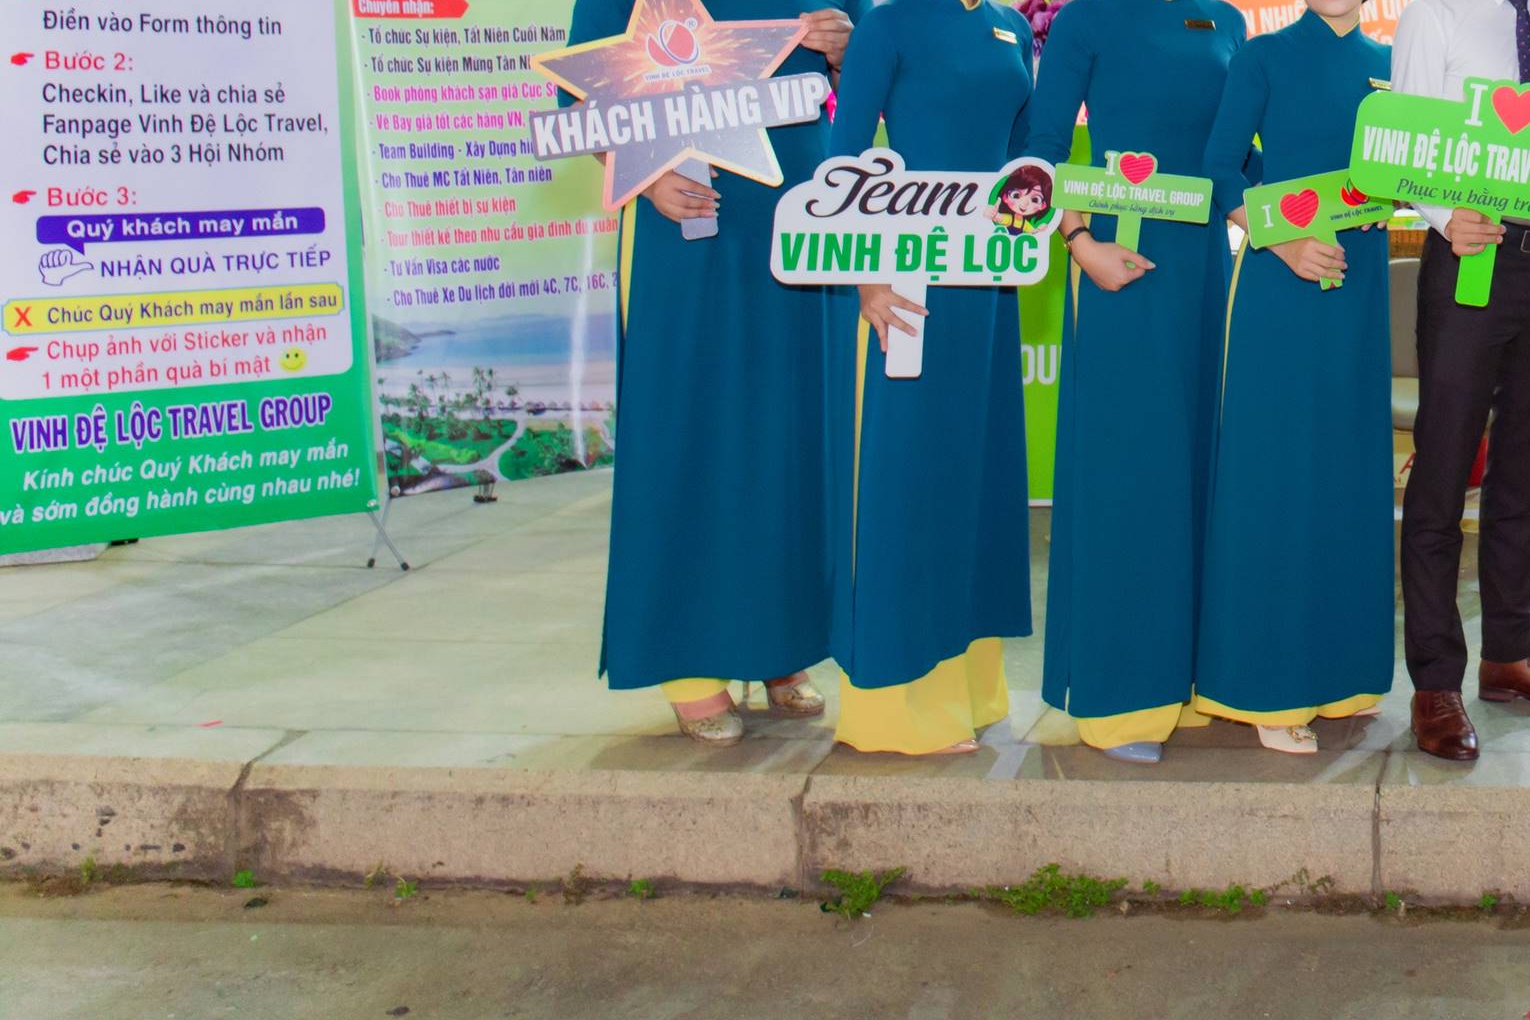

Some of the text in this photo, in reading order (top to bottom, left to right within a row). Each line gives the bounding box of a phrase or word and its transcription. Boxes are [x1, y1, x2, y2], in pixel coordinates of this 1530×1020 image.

[43, 7, 282, 39] Điền vào Form thông tin
[45, 51, 134, 70] Bước 2:
[42, 81, 285, 105] Checkin, Like và chia sẻ
[1465, 84, 1487, 126] I
[533, 79, 828, 158] KHÁCH HÀNG VIP
[1363, 126, 1408, 165] VINH
[1414, 130, 1440, 179] ĐỆ
[1446, 133, 1480, 181] LỘC
[382, 166, 552, 189] Cho Thuê MC Tất Niên, Tân niên
[805, 157, 979, 218] Team
[1064, 180, 1204, 207] VINH ĐỆ LỘC TRAVEL GROUP
[1395, 178, 1433, 200] Phục
[1436, 188, 1462, 204] vụ
[1466, 183, 1507, 211] bằng
[66, 211, 298, 241] Quý khách may mắn
[101, 244, 331, 278] NHẬN QUÀ TRỰC TIẾP
[779, 225, 1038, 281] VINH ĐỆ LỘC
[11, 394, 332, 453] VINH ĐỆ LỘC TRAVEL GROUP
